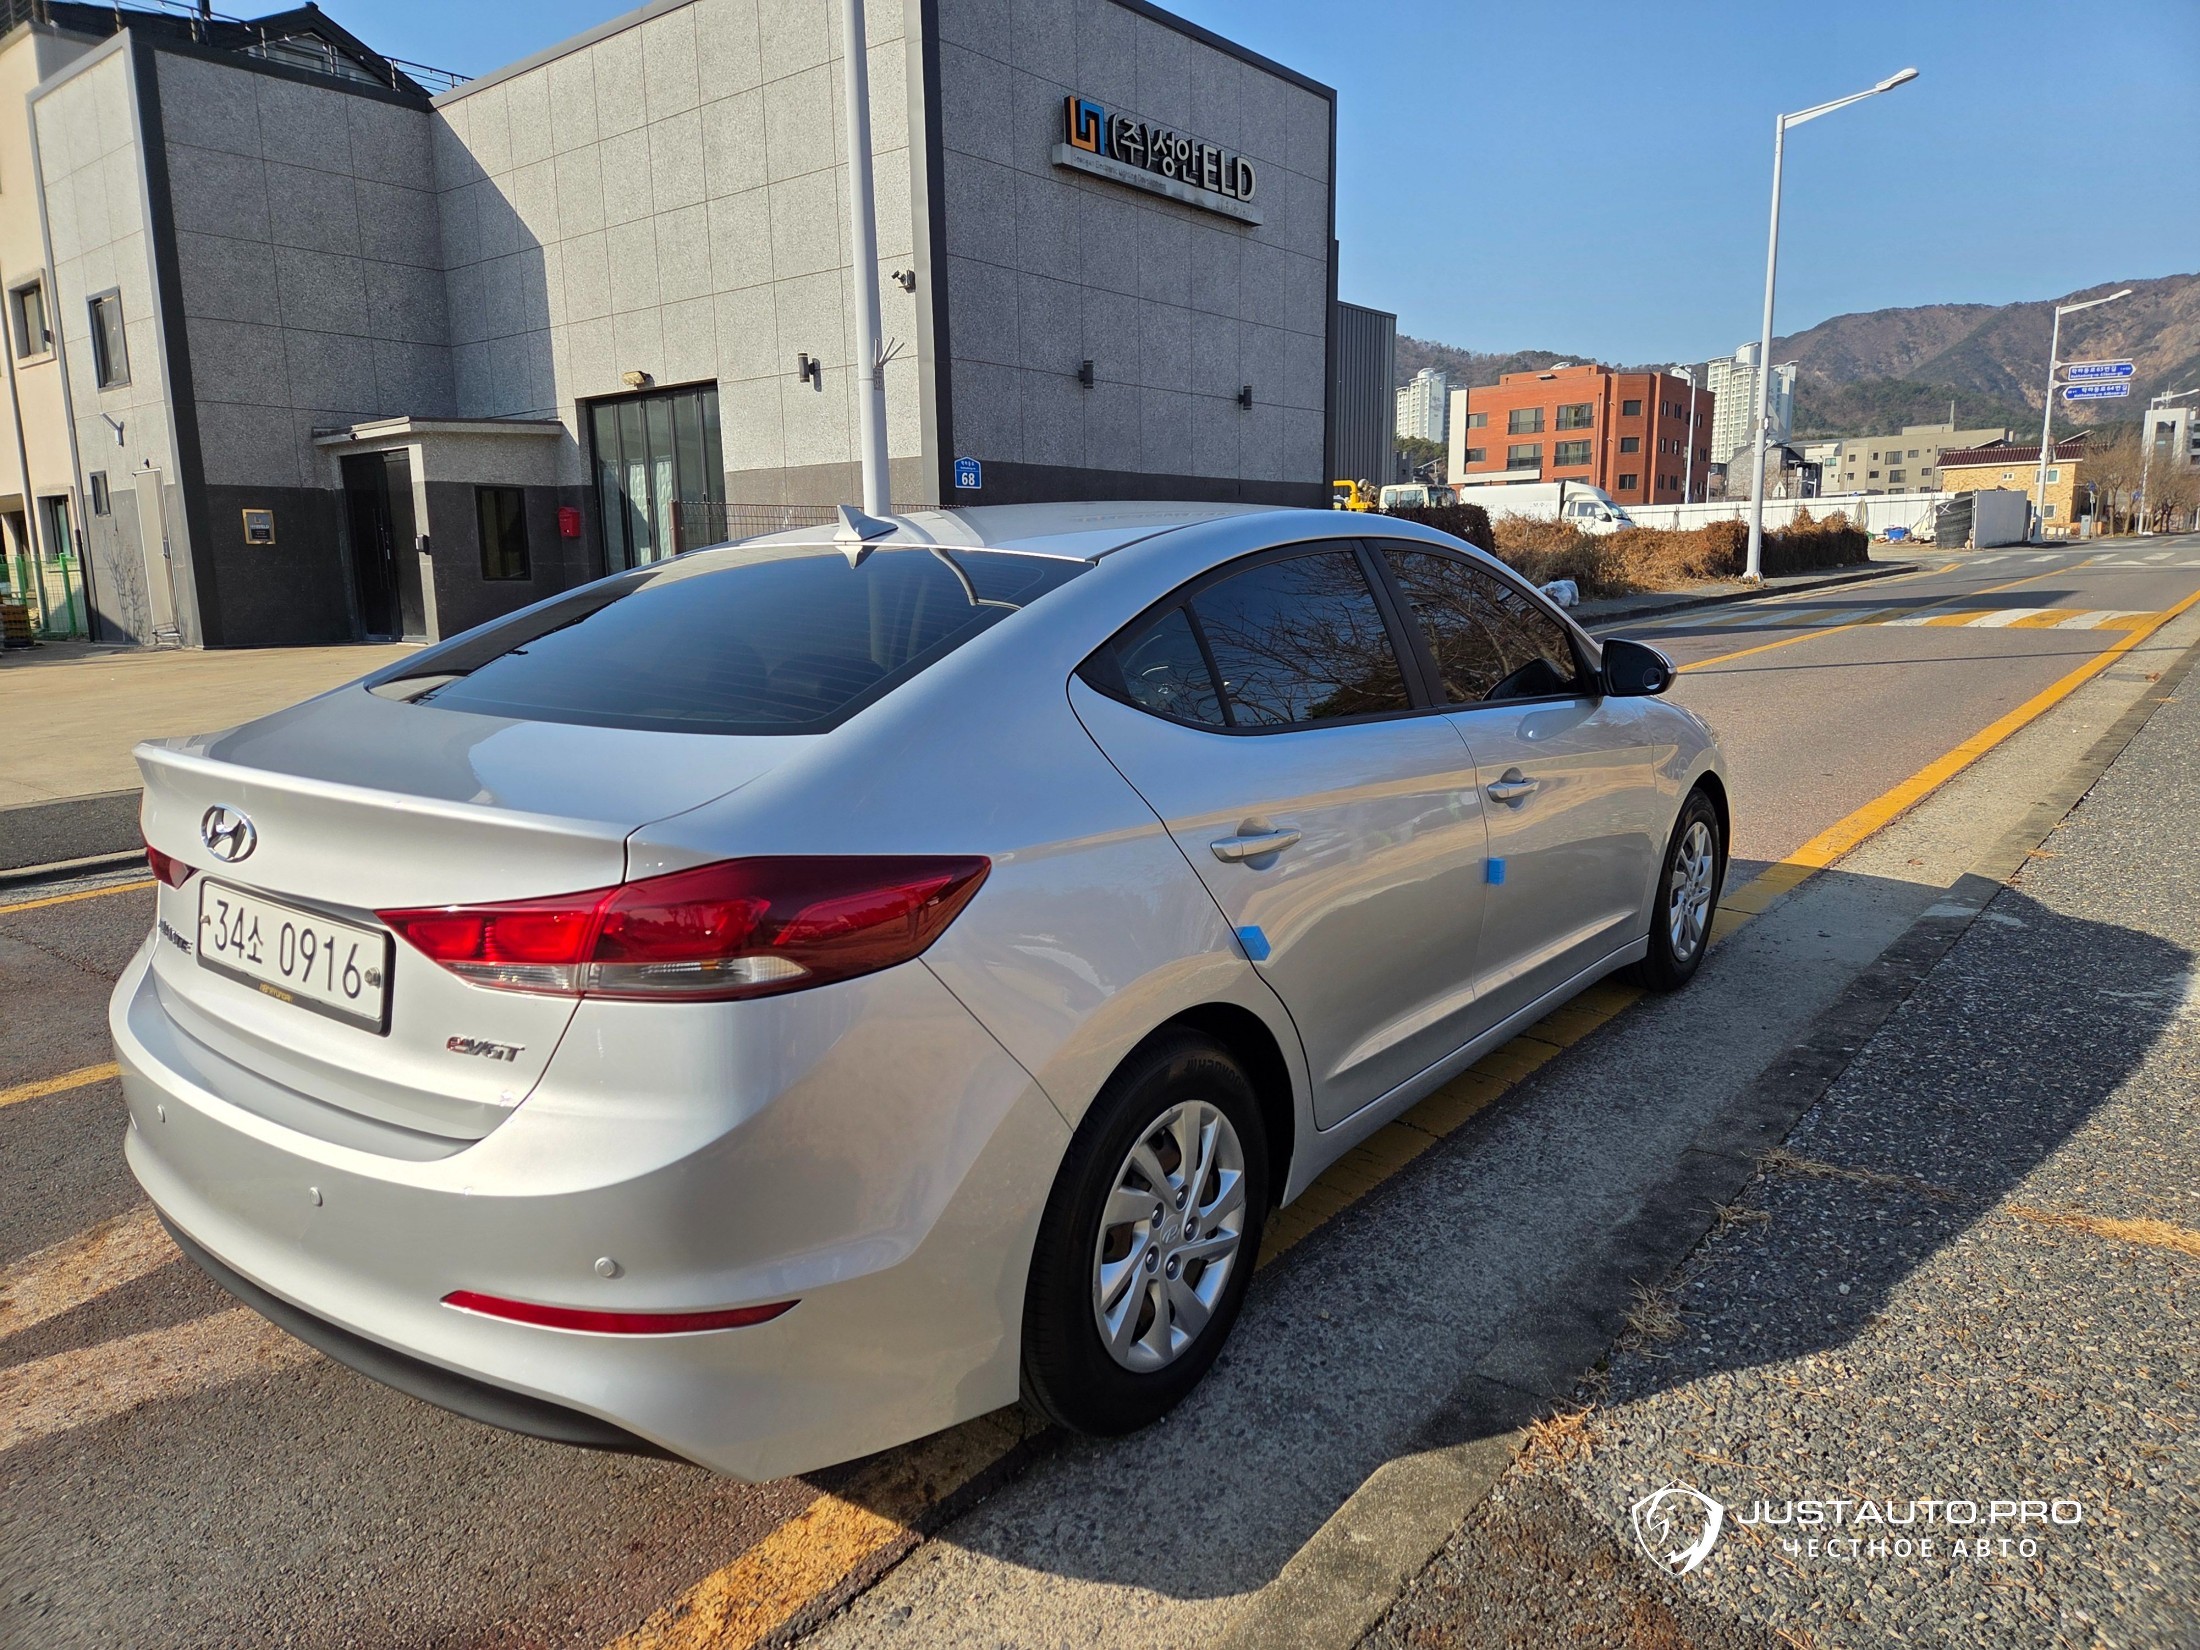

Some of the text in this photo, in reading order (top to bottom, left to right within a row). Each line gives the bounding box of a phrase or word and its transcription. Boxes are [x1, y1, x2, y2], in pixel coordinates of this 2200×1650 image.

[1110, 113, 1257, 201] (주)성안ELD
[961, 472, 975, 486] 68
[214, 899, 362, 999] 34소 0916
